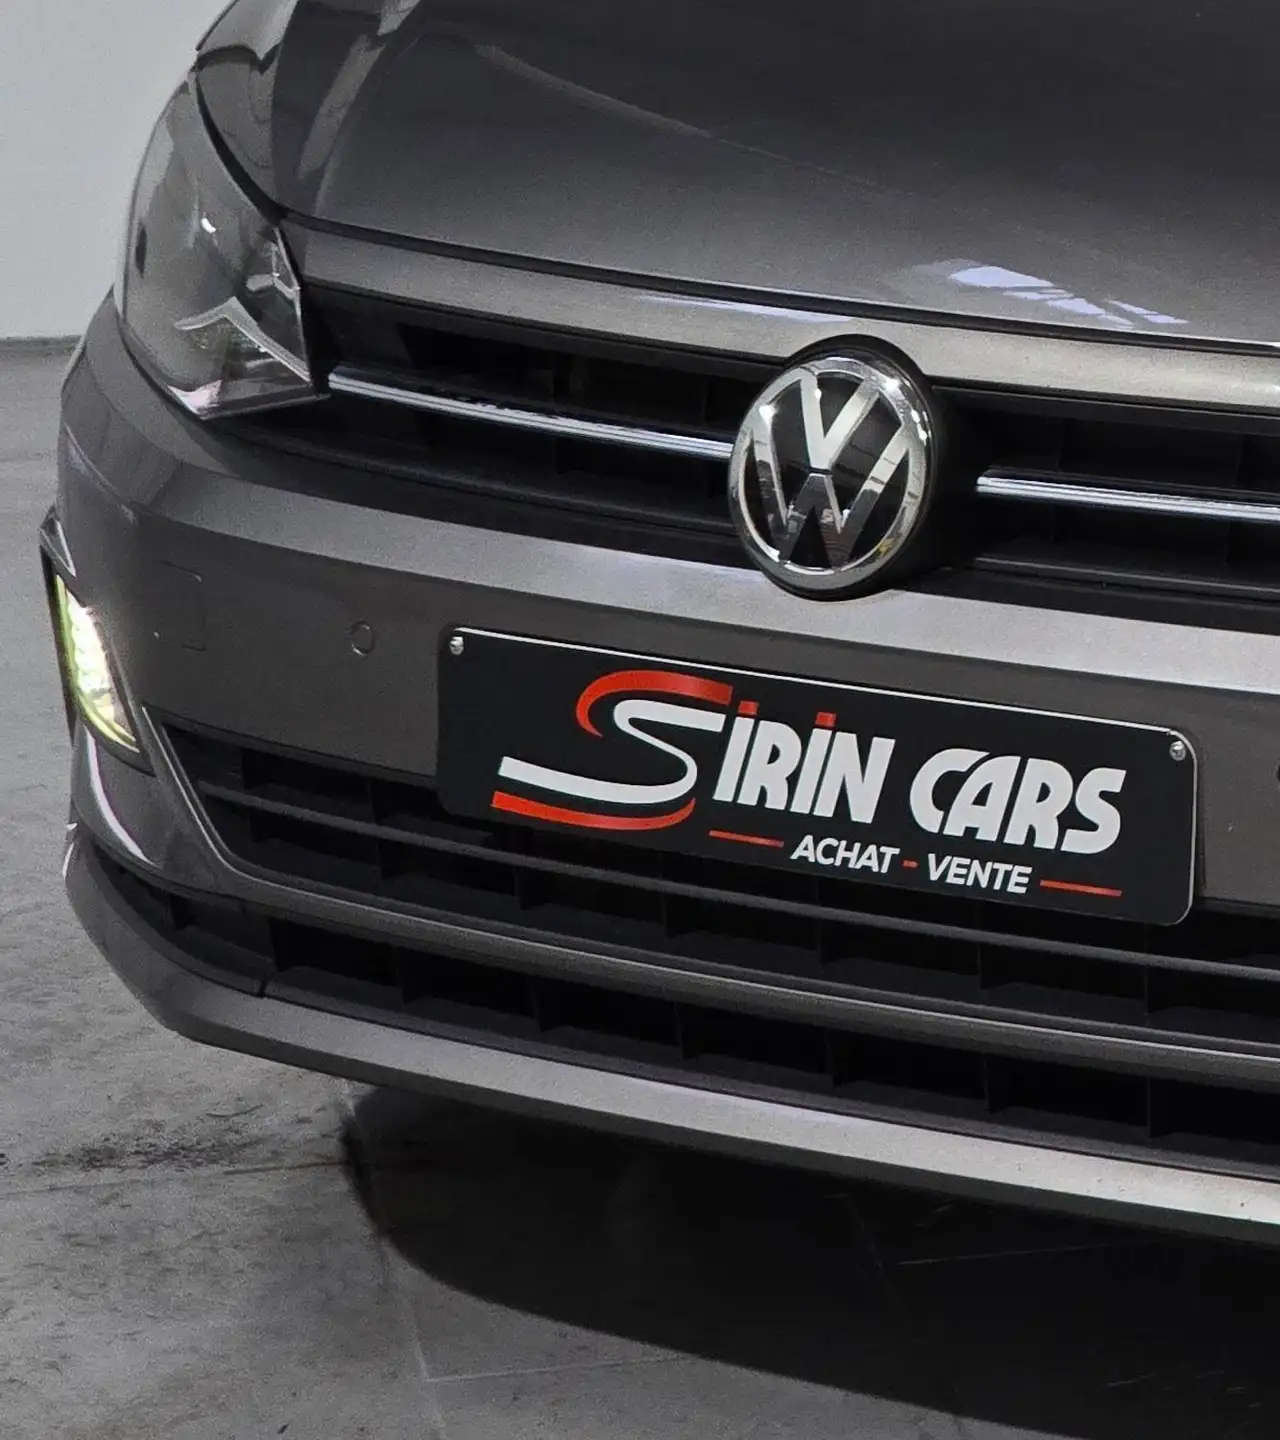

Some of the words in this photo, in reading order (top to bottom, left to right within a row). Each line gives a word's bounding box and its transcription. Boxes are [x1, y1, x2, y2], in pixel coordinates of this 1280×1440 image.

[909, 748, 1127, 855] CARS
[791, 834, 900, 875] ACHAT
[926, 853, 1033, 895] VENTE
